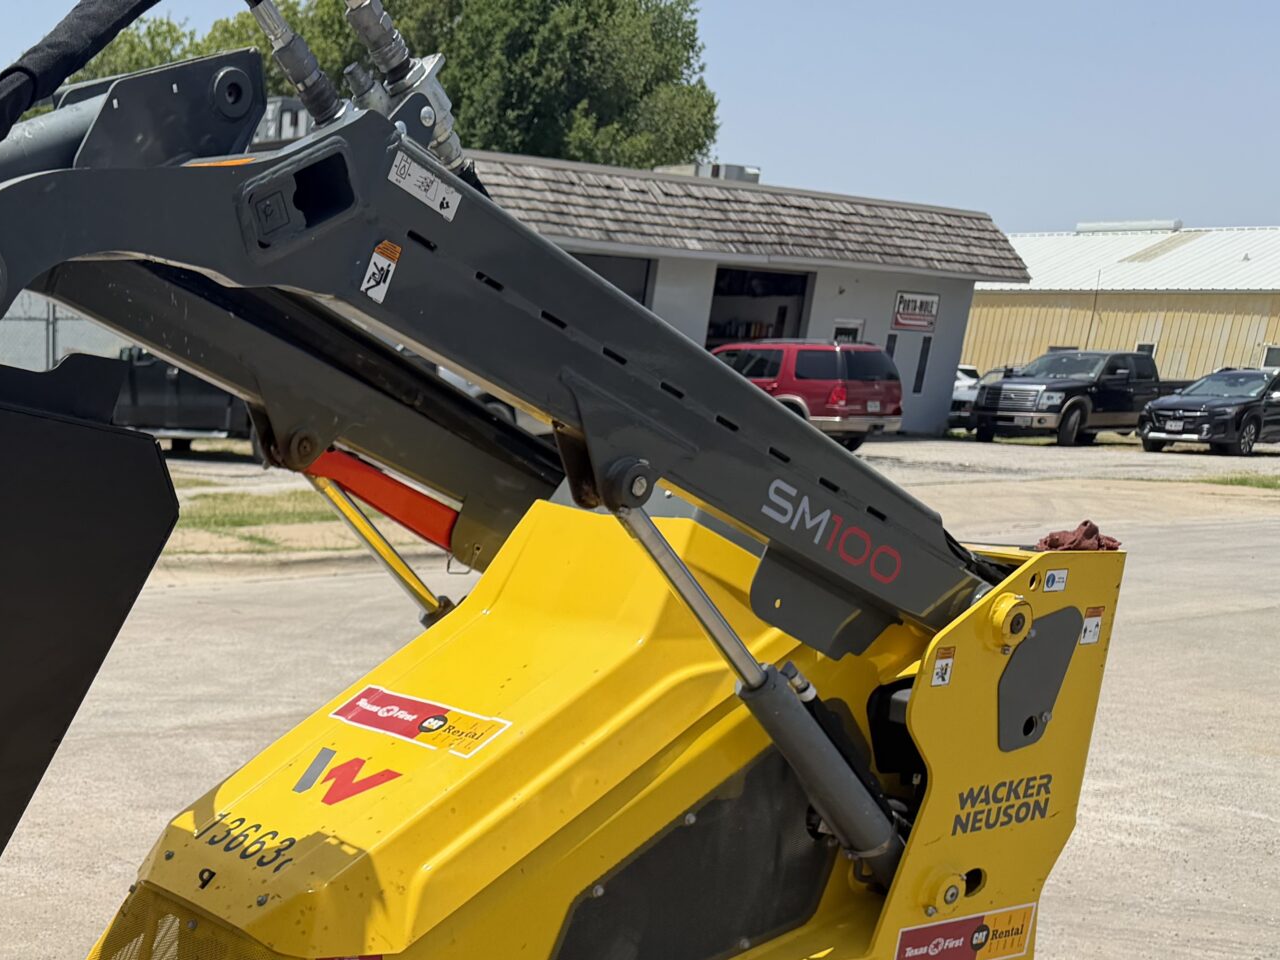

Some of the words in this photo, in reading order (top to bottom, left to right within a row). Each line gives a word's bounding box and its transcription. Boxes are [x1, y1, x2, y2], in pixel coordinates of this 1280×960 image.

[761, 479, 902, 584] SM100
[394, 708, 418, 722] First
[422, 716, 445, 730] CAT
[958, 774, 1053, 811] WACKER
[951, 797, 1050, 837] NEUSON
[194, 812, 296, 873] 13663
[904, 945, 929, 958] Texas
[943, 936, 965, 950] First
[972, 929, 988, 945] CAT
[990, 923, 1025, 941] Rental
